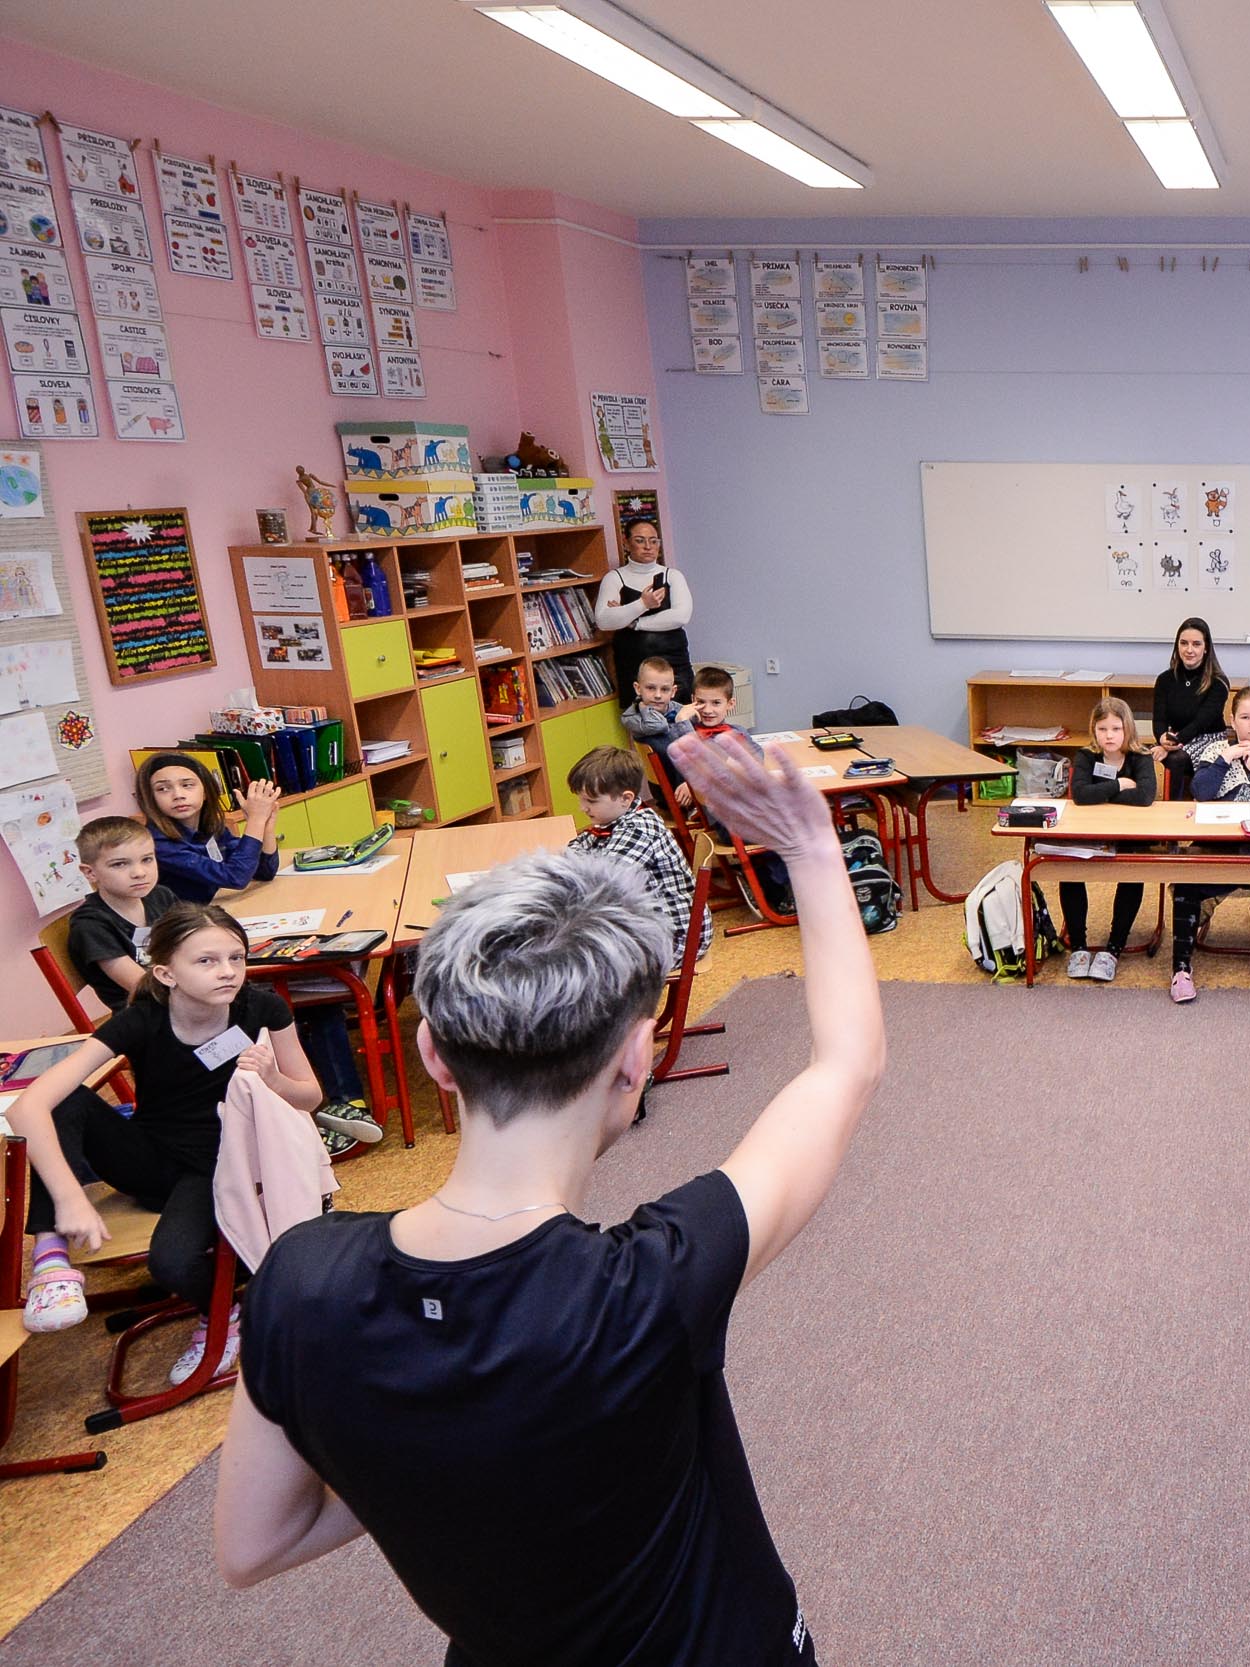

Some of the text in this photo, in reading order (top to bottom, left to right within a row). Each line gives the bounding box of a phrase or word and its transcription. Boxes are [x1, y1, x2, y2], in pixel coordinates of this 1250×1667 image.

[245, 178, 272, 191] SLOVESA
[255, 234, 281, 246] SLOVESA
[111, 263, 136, 274] SPOJKY
[266, 288, 292, 299] SLOVESA
[889, 303, 918, 312] ROVINA
[708, 338, 723, 346] BOD
[39, 380, 71, 388] SLOVESA
